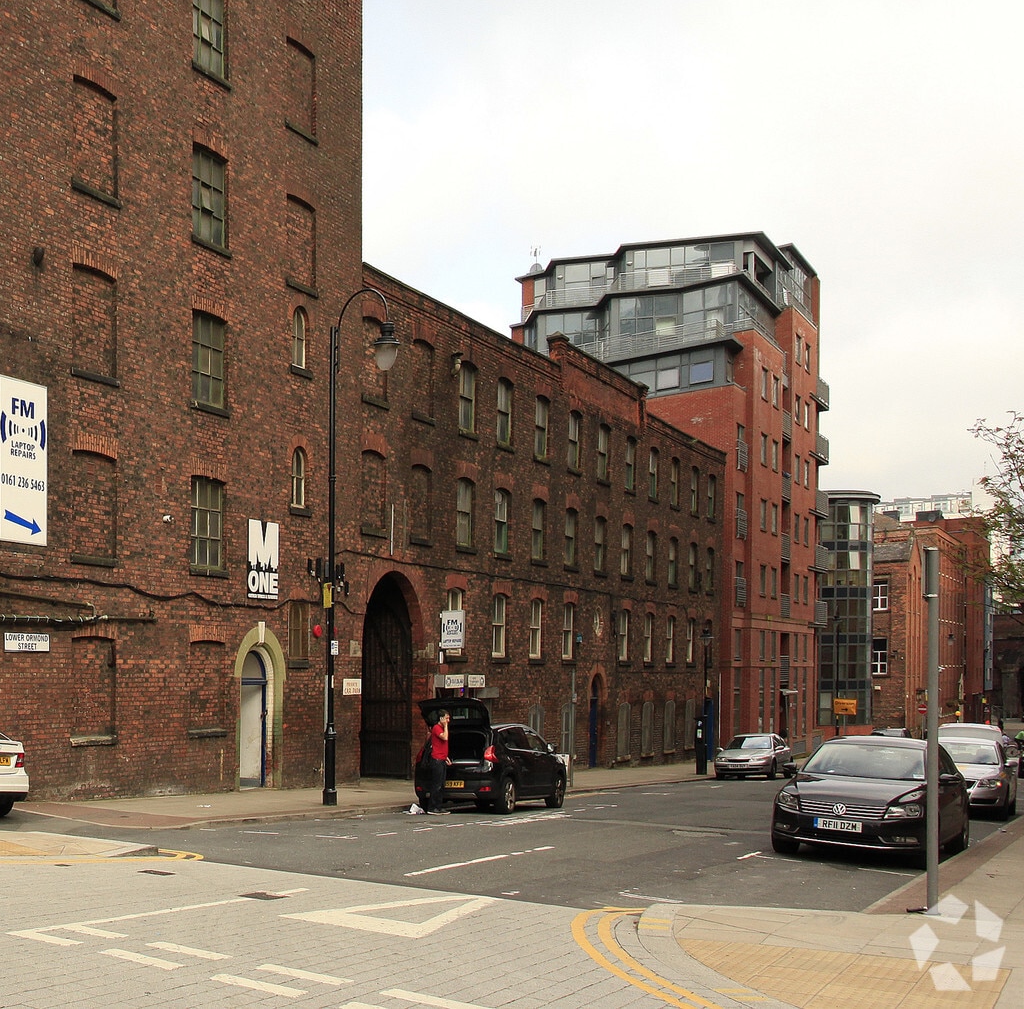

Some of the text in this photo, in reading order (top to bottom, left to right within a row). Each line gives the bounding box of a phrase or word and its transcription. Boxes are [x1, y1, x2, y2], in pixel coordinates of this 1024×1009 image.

[11, 397, 35, 419] FM
[11, 440, 35, 451] LAPTOP
[10, 448, 36, 460] REPAIRS
[1, 473, 45, 492] 0161 236 5463
[248, 518, 279, 570] M
[248, 570, 278, 594] ONE
[5, 633, 49, 642] LOWER ORMOND
[822, 820, 857, 831] RF11 DZM
